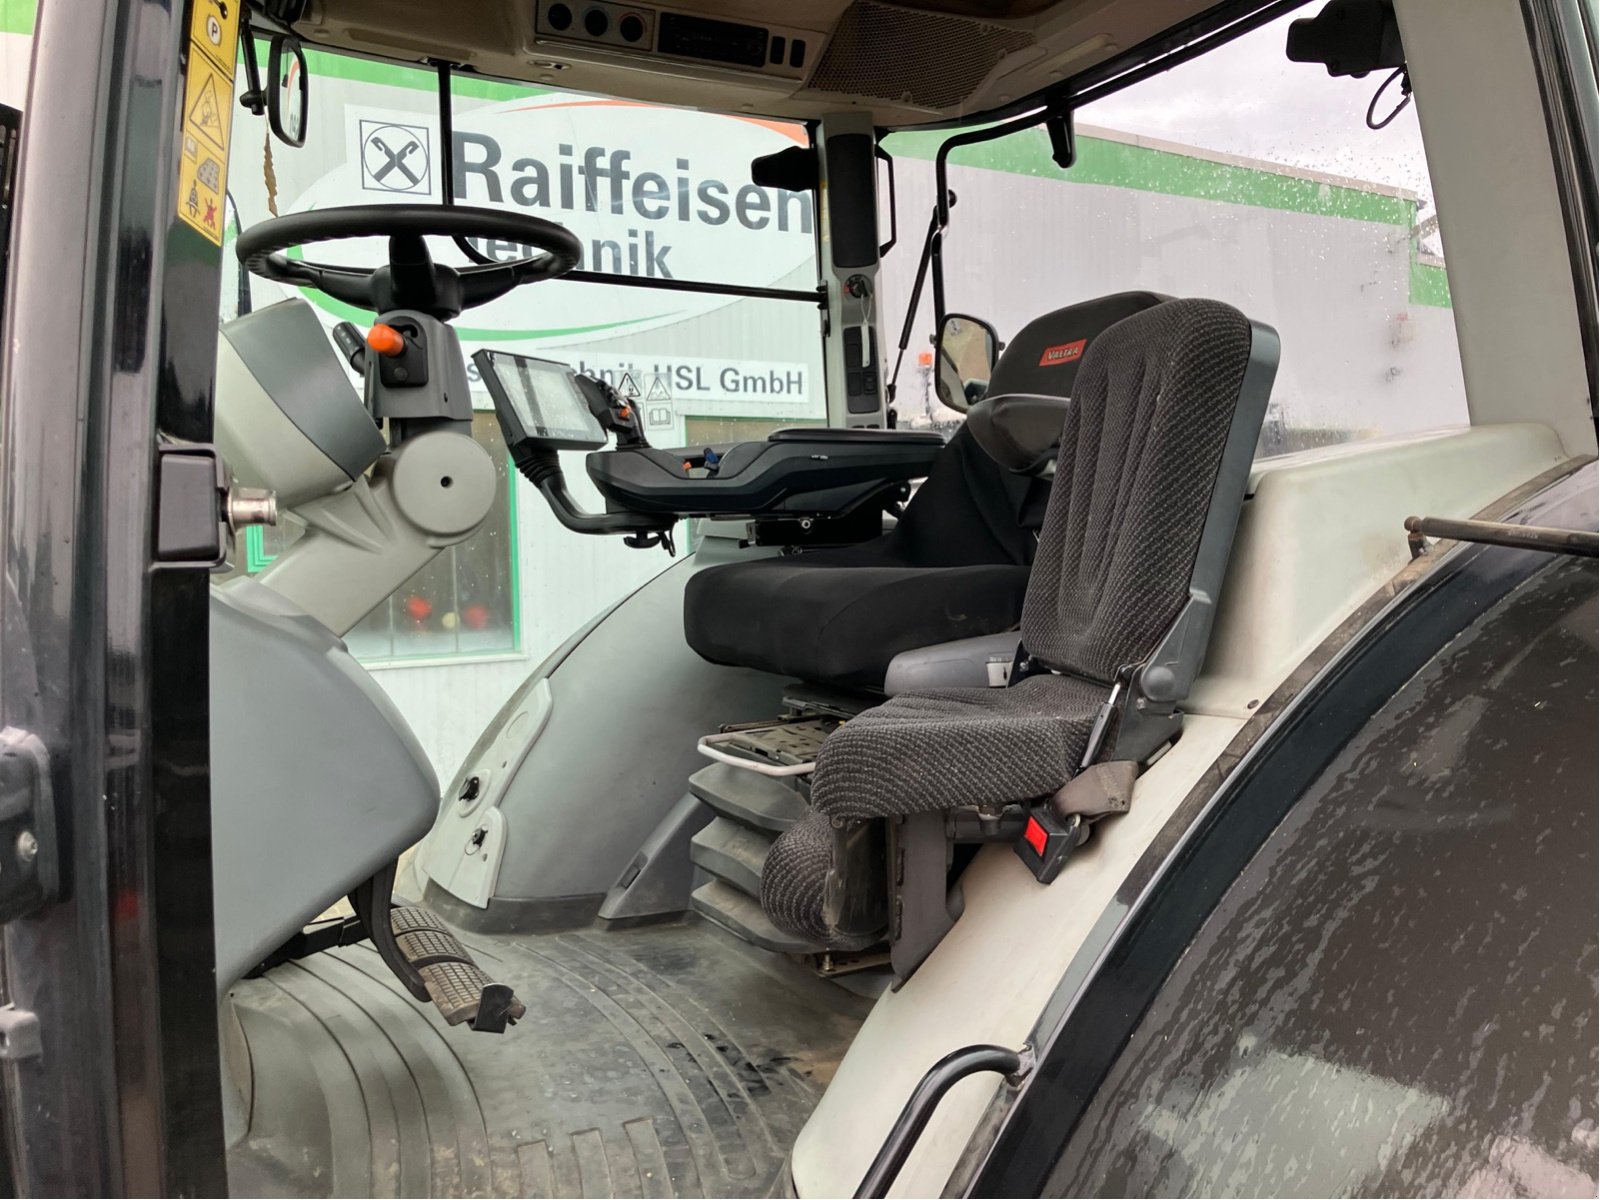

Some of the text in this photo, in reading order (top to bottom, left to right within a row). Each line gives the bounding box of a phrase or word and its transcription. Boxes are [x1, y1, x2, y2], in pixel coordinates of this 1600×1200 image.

[452, 130, 812, 234] Raiffeisen
[1047, 346, 1079, 360] VALTRA
[720, 367, 803, 395] GmbH
